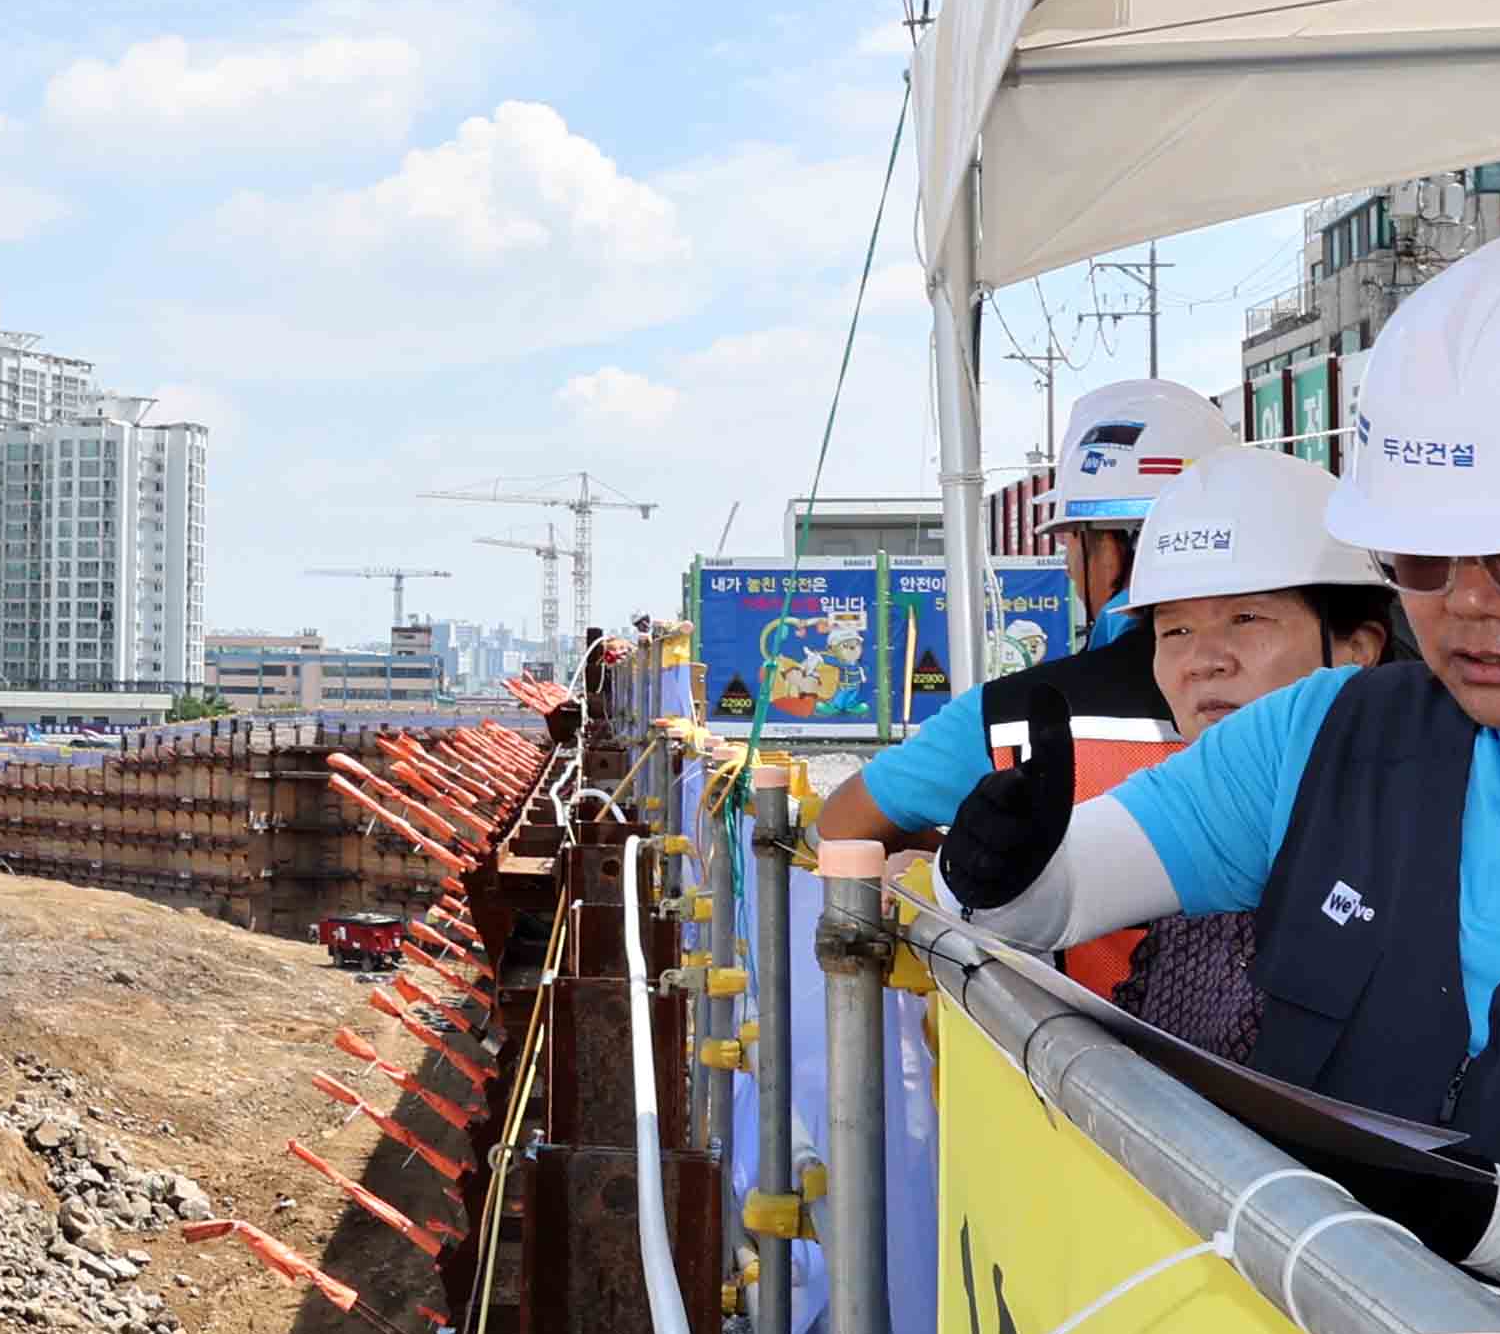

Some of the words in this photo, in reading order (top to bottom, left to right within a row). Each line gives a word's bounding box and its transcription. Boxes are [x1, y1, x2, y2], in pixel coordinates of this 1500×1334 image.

[1382, 435, 1477, 471] 두산건설
[1155, 529, 1232, 554] 두산건설
[710, 576, 742, 593] 내가
[1321, 879, 1376, 926] We've
